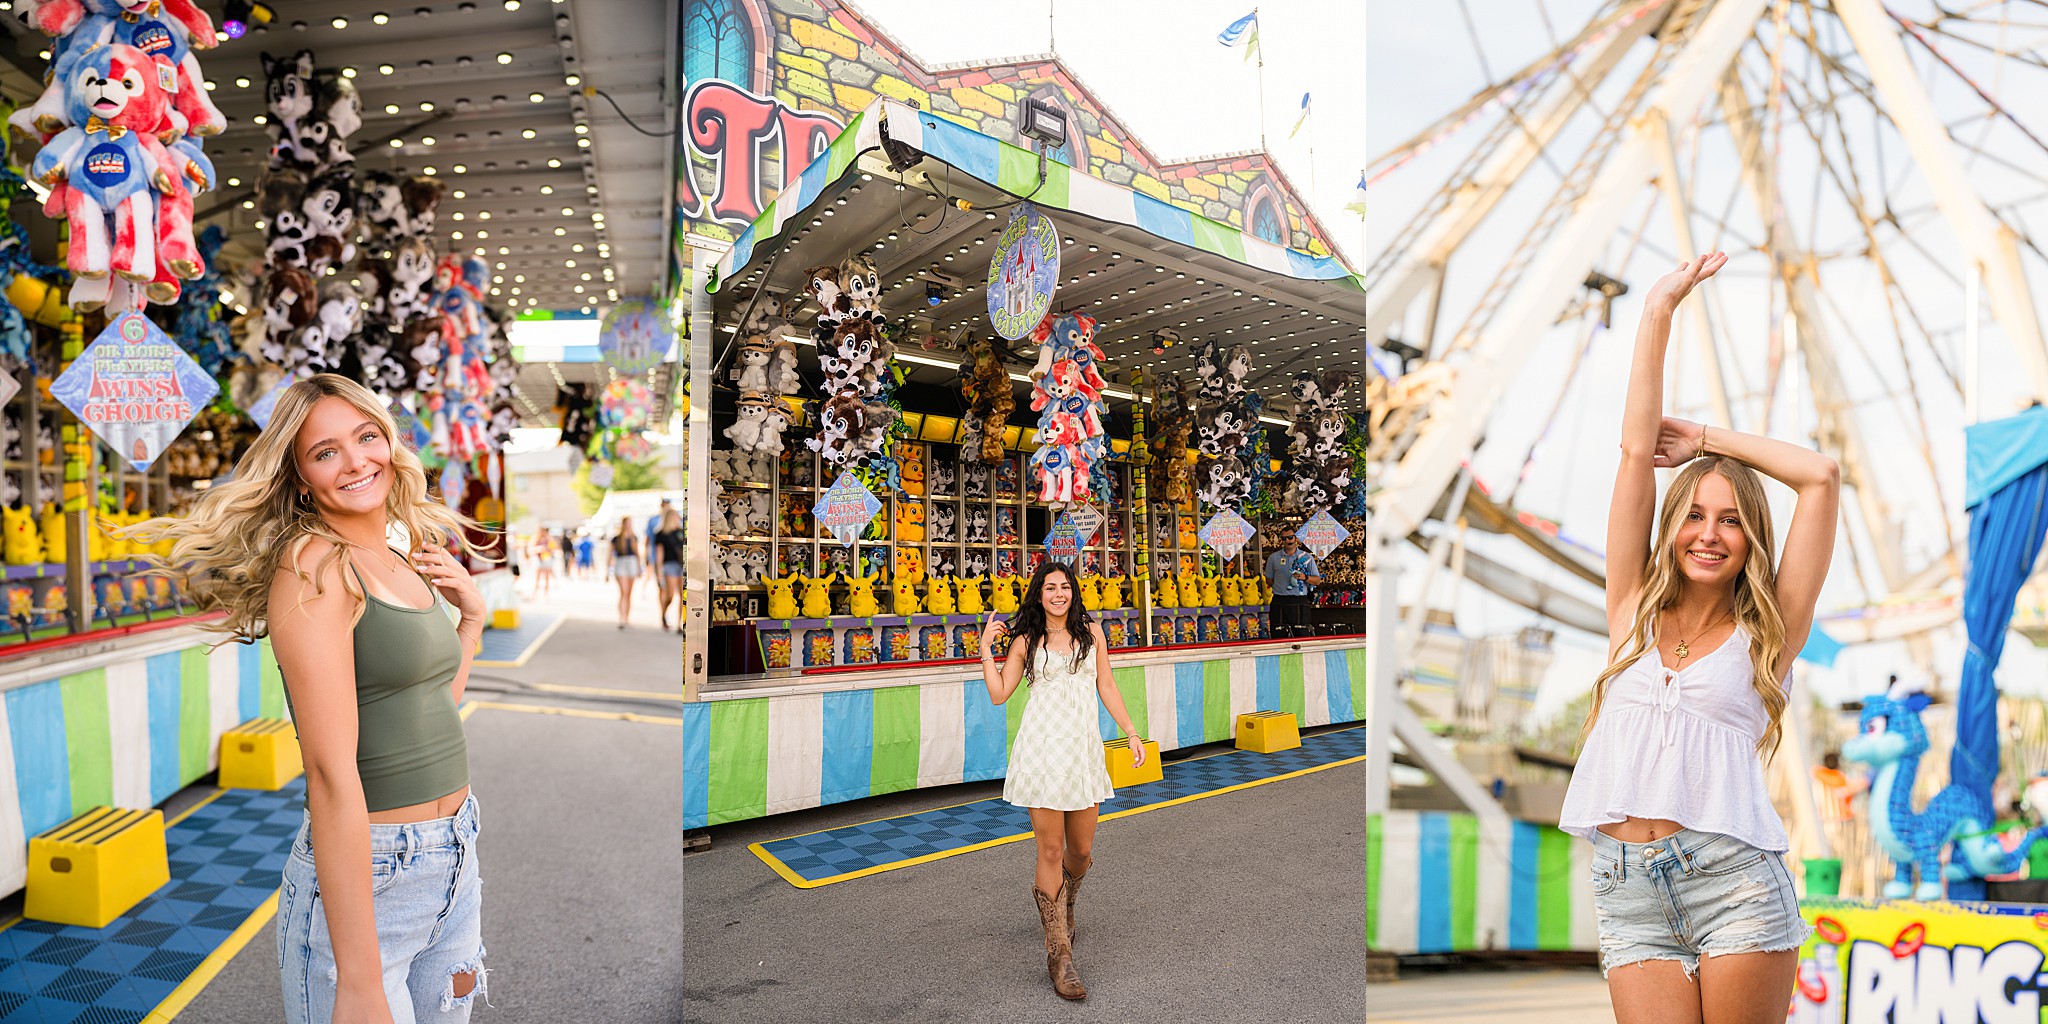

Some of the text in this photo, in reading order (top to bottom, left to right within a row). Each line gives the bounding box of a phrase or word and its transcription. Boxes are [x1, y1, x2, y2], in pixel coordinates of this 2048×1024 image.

[88, 153, 125, 173] USA
[988, 215, 1057, 288] WATER FUN
[994, 291, 1048, 338] CASTLE
[123, 319, 145, 341] 6
[94, 345, 175, 358] OR MORE
[95, 359, 175, 372] PLAYERS
[99, 378, 174, 397] WINS
[83, 402, 191, 422] CHOICE
[824, 514, 870, 526] CHOICE
[1850, 938, 2045, 1024] RING
